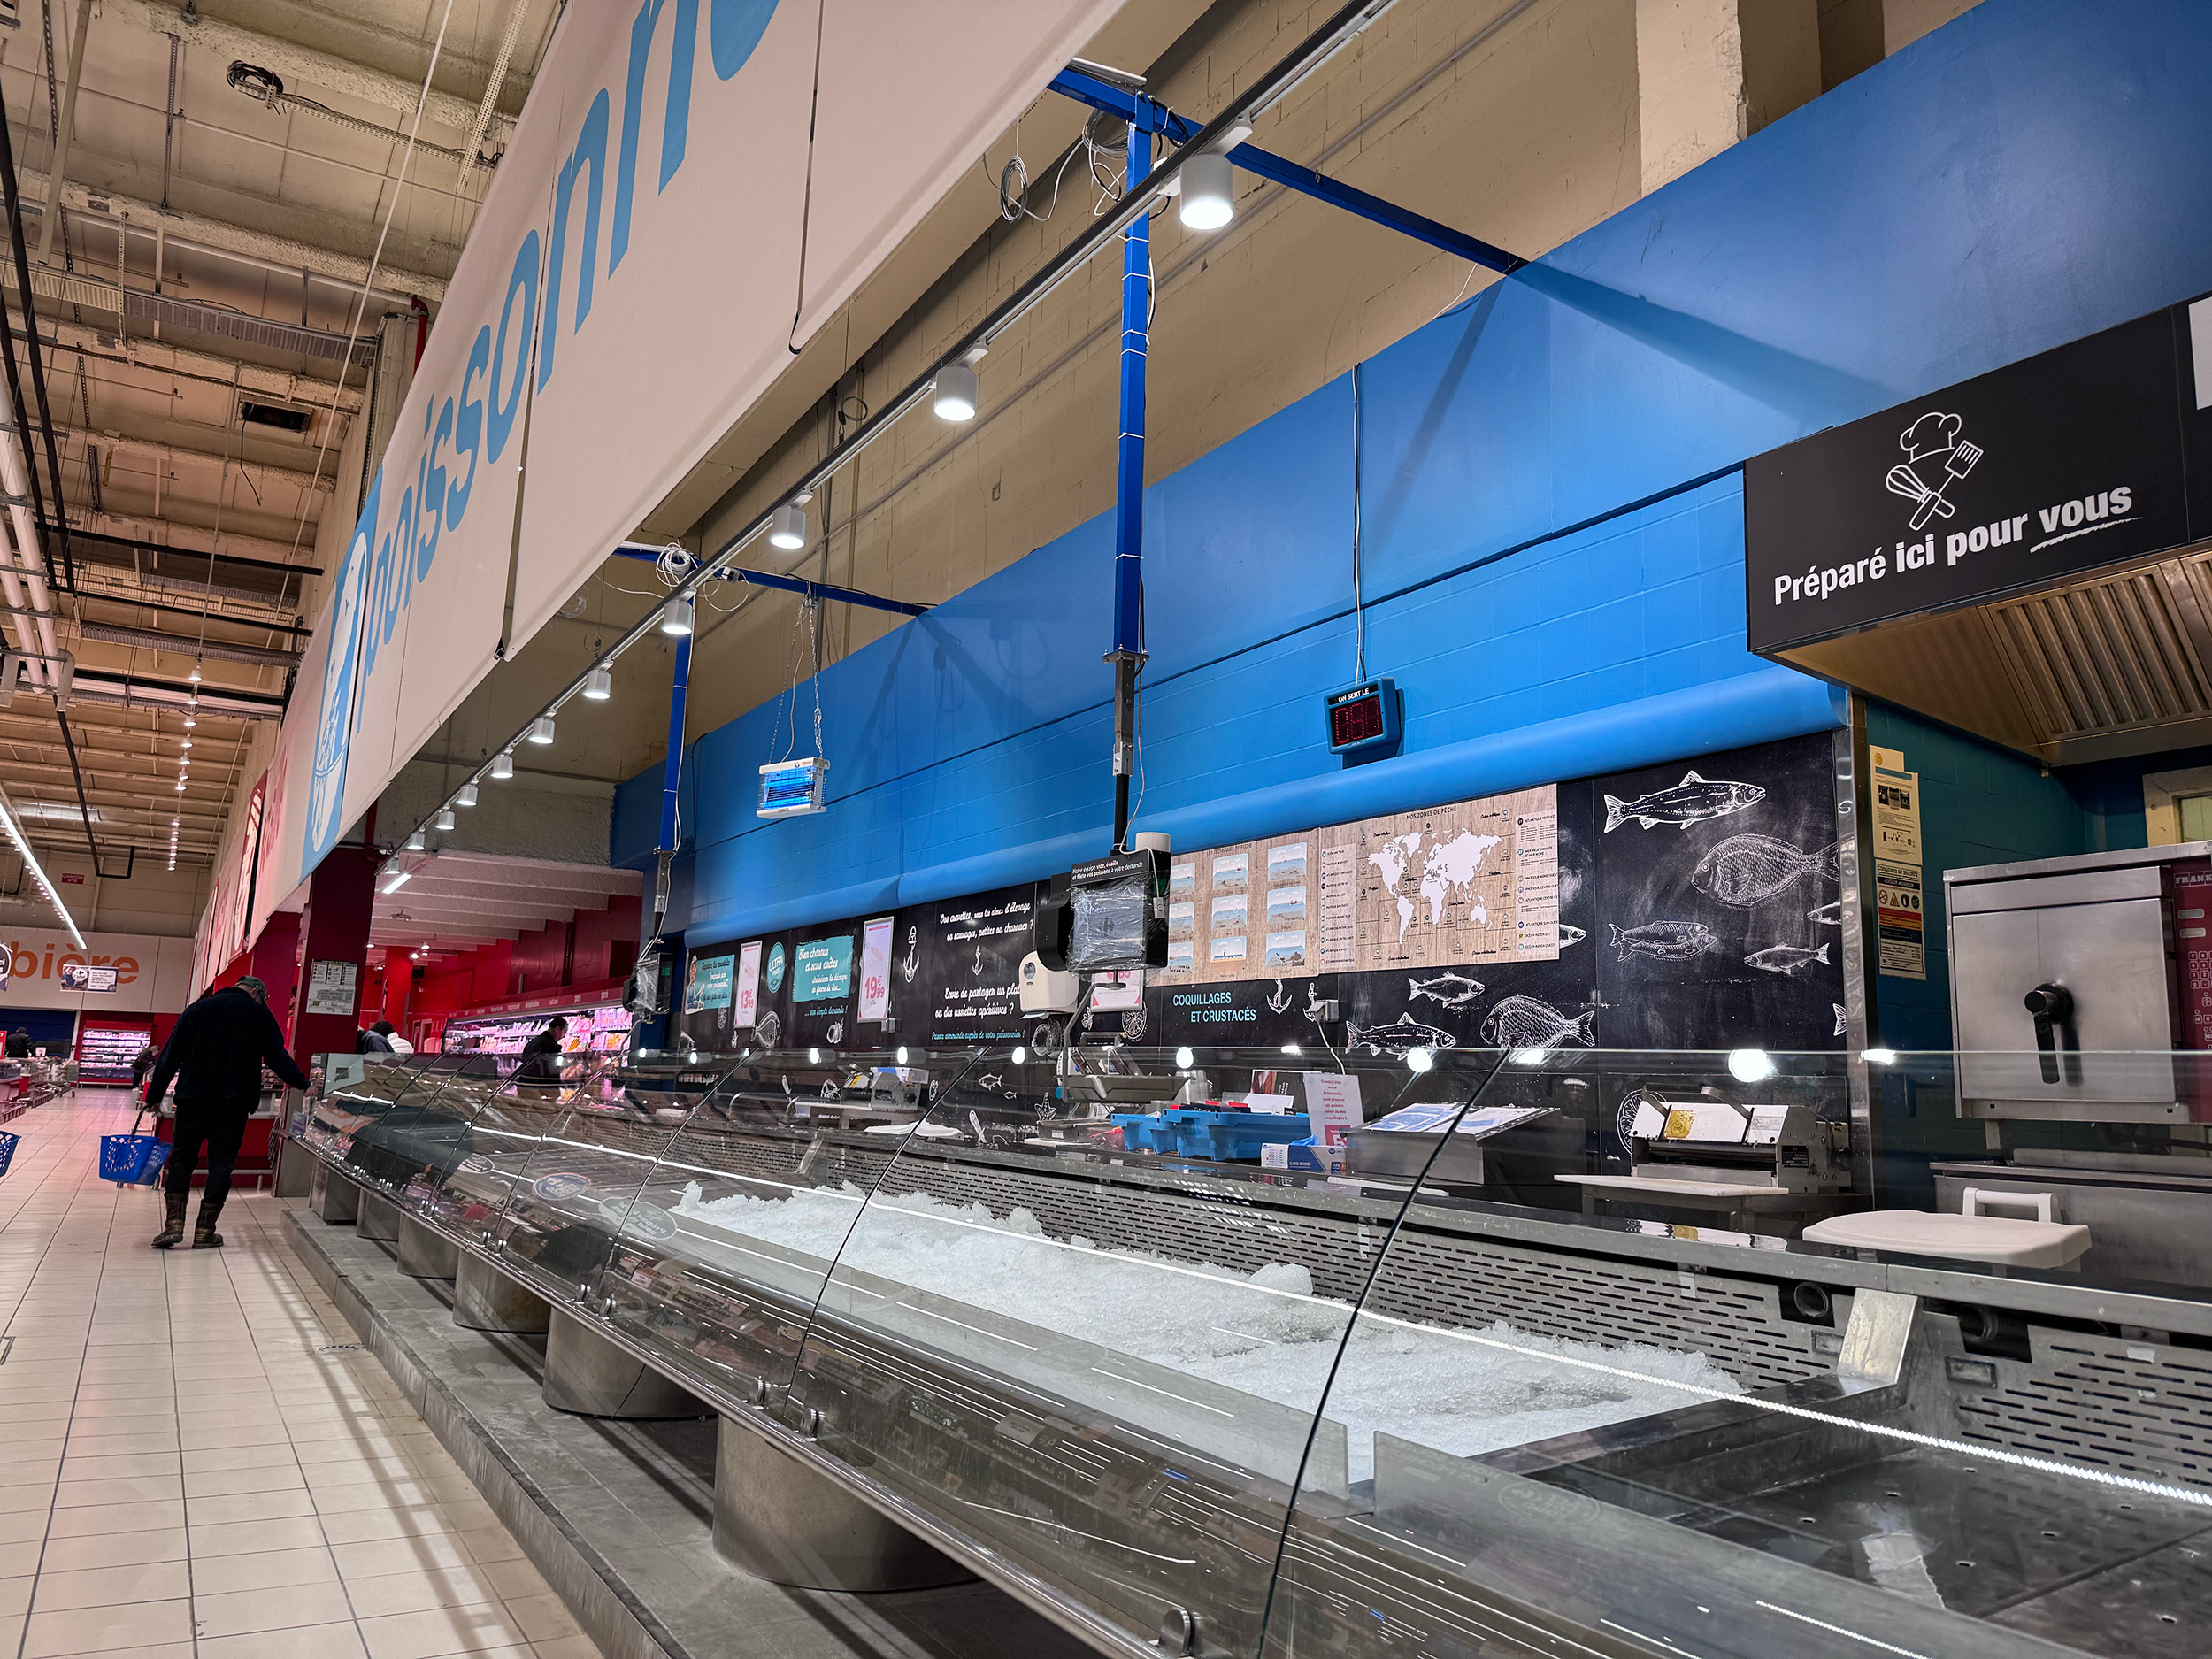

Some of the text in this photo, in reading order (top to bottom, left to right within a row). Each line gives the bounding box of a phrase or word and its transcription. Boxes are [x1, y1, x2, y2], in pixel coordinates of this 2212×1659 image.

[1774, 486, 2132, 605] Préparé ici pour vous
[1347, 690, 1361, 700] SERT
[1417, 810, 1432, 818] ZONES
[1440, 805, 1457, 814] PÊCHE
[940, 913, 949, 925] Vos
[949, 911, 972, 923] crevettes,
[1004, 902, 1031, 915] d'élevage
[946, 919, 1034, 942] ou sauvages, petites ou charnues ?
[10, 941, 139, 984] bière
[798, 947, 829, 961] Bien charnus
[769, 955, 783, 972] ULTRA
[805, 956, 839, 972] et sans arêtes
[944, 987, 959, 1000] Envie
[960, 987, 968, 998] de
[968, 987, 995, 1001] partager
[997, 987, 1006, 996] un
[1172, 992, 1232, 1007] COQUILLAGES
[934, 1009, 943, 1018] ou
[943, 1006, 953, 1018] des
[954, 1004, 977, 1018] assiettes
[978, 1002, 1008, 1019] apéritives
[1190, 1006, 1257, 1023] ET CRUSTACÉS
